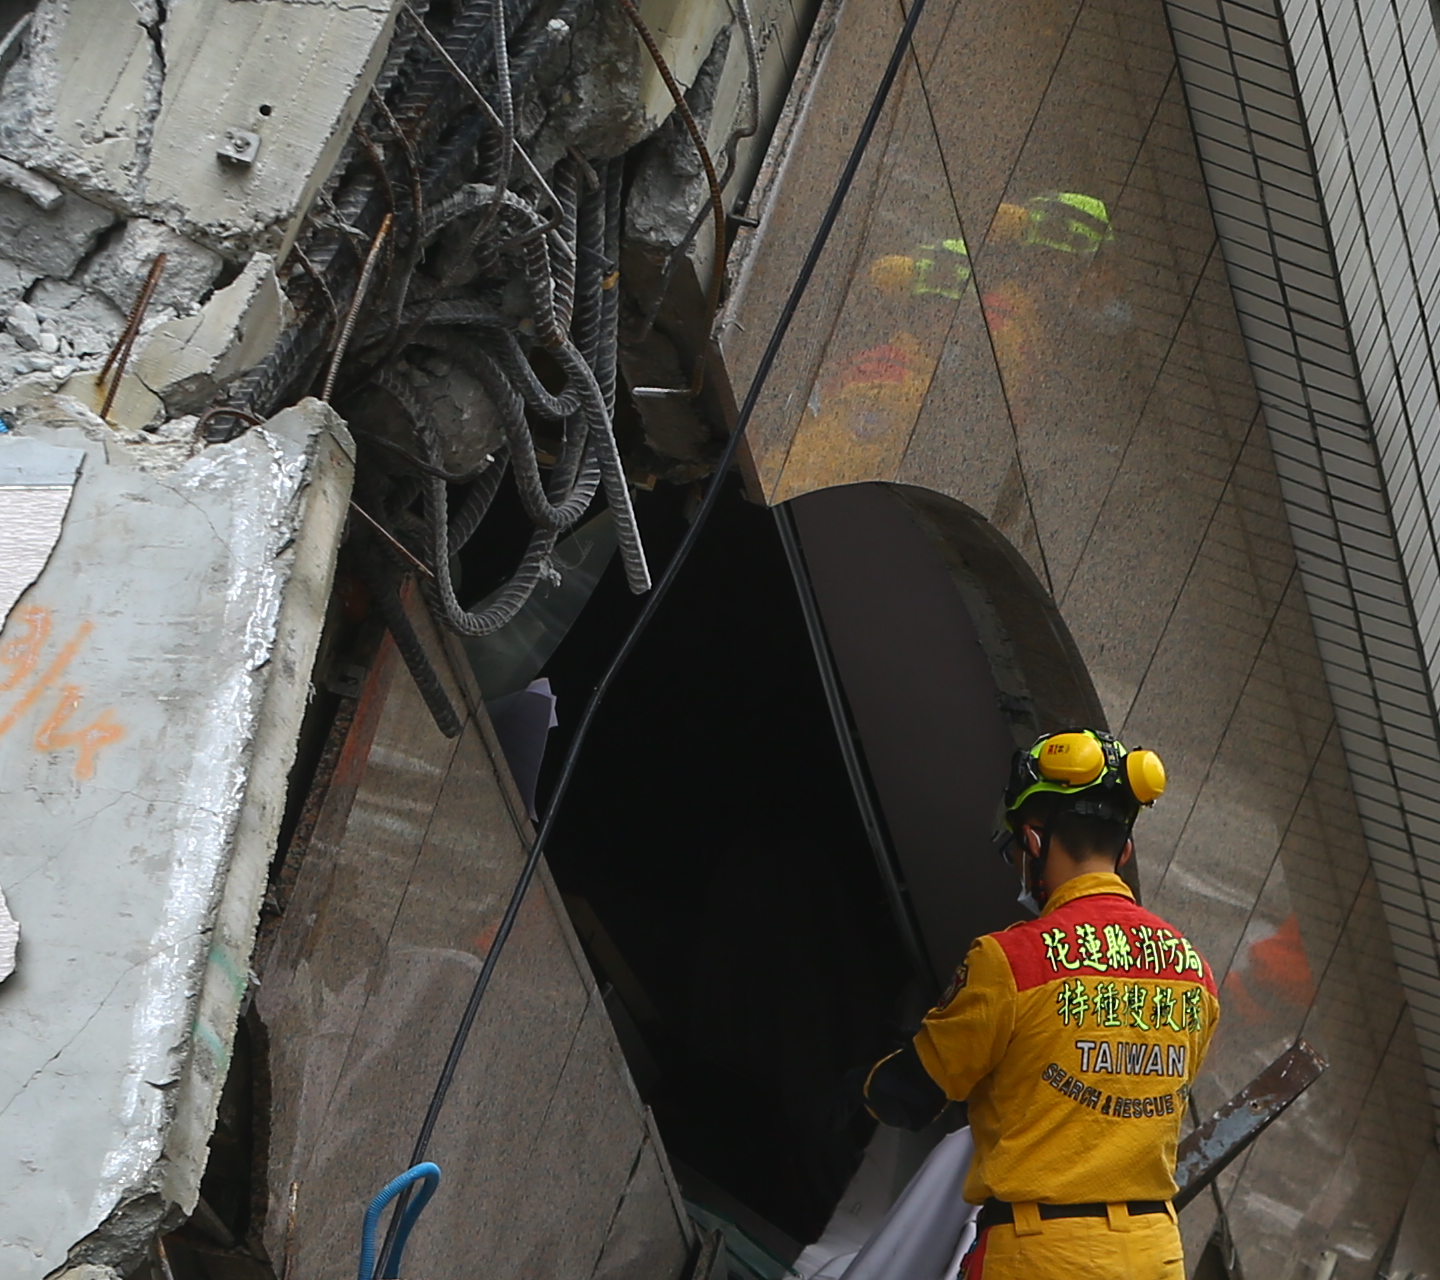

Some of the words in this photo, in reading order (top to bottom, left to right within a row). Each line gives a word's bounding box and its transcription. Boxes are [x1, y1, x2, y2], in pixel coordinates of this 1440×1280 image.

[1042, 923, 1204, 978] 花蓮縣消防局
[1075, 1040, 1186, 1077] TAIWAN
[1042, 1063, 1102, 1110] SEARCH
[1101, 1095, 1113, 1115] &
[1113, 1093, 1175, 1118] RESCUE
